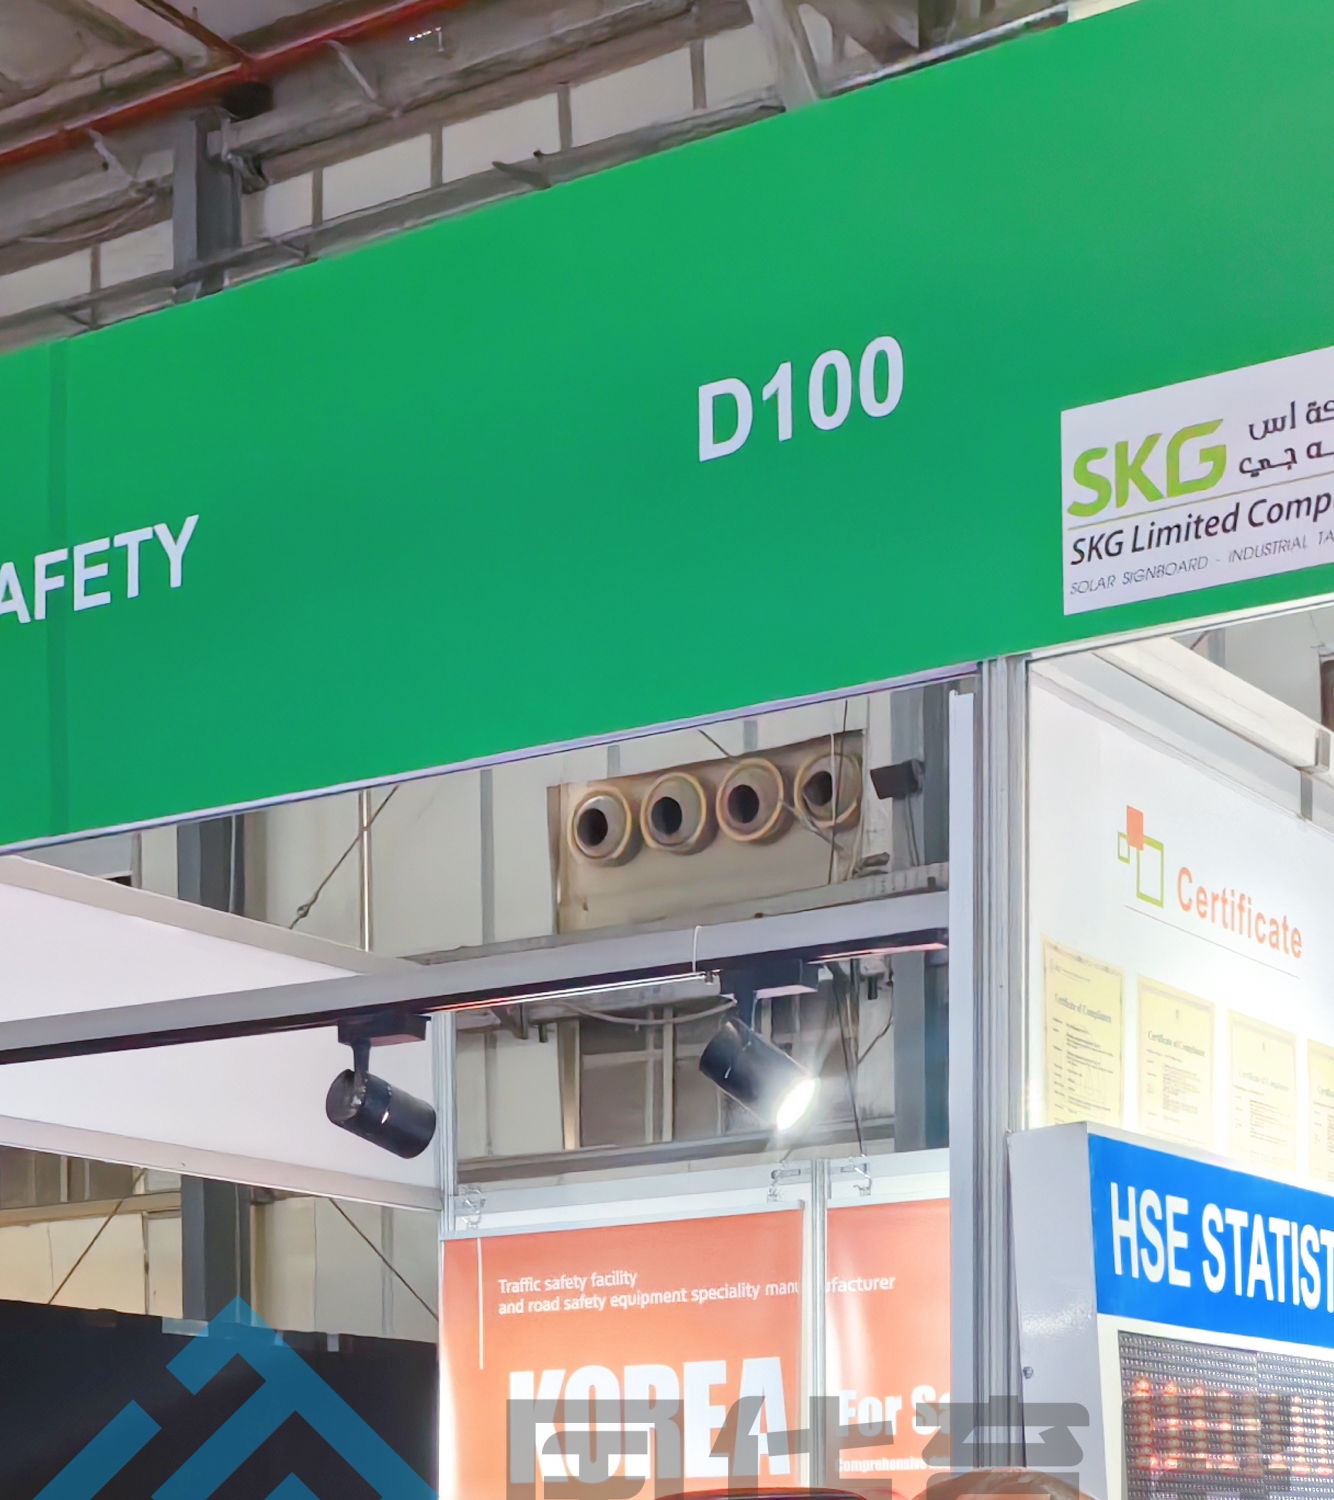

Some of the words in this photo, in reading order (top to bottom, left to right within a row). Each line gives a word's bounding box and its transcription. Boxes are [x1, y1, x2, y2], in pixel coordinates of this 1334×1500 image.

[698, 335, 905, 462] D100
[1067, 418, 1227, 517] SKG
[1070, 530, 1123, 566] SKG
[1131, 502, 1241, 554] Limited
[1070, 574, 1116, 594] SOLAR
[1122, 556, 1208, 585] SIGNBOARD
[1228, 532, 1308, 563] INDUSTRIAL
[1176, 866, 1303, 960] Certificate
[1110, 1180, 1191, 1289] HSE
[498, 1276, 541, 1295] Traffic
[544, 1273, 587, 1294] safety
[590, 1270, 638, 1289] facility
[498, 1299, 524, 1315] and
[528, 1296, 560, 1313] road
[563, 1294, 606, 1314] safety
[610, 1288, 687, 1311] equipment
[691, 1281, 760, 1304] speciality
[509, 1356, 791, 1484] KOREA
[837, 1388, 903, 1438] For
